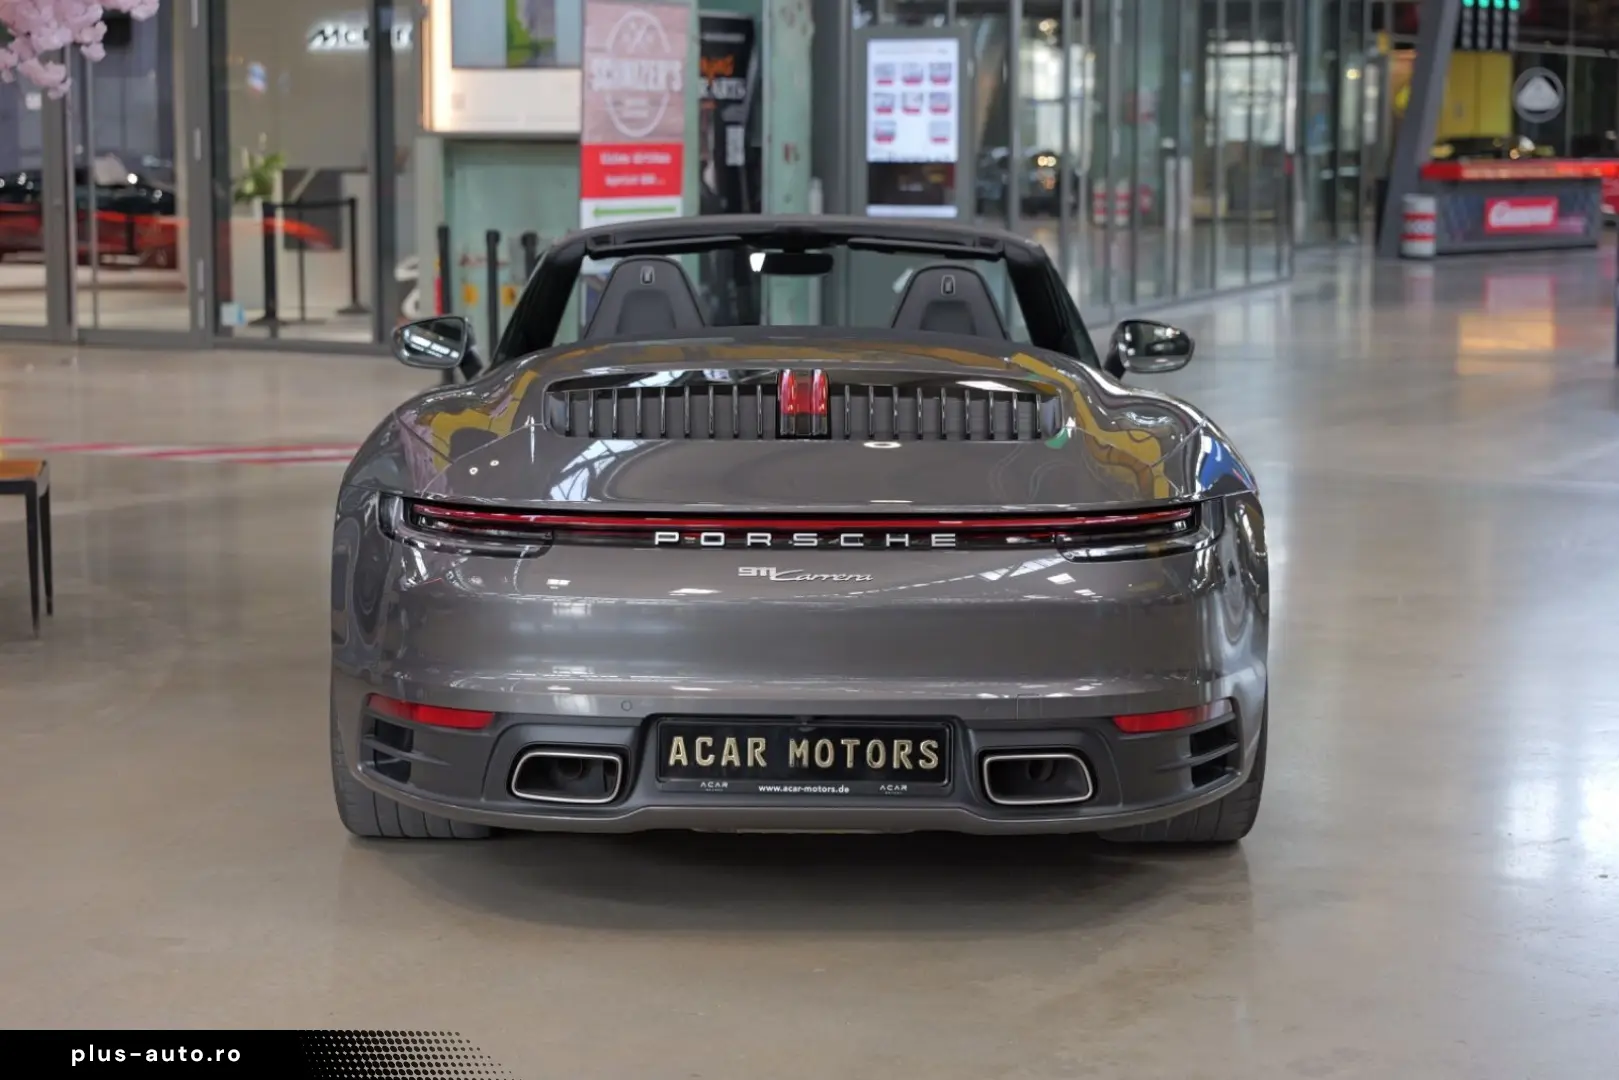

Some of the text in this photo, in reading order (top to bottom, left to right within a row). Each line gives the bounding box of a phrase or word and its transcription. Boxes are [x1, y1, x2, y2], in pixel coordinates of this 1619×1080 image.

[654, 531, 957, 547] PORSCHE
[738, 566, 873, 582] 911 Carrera
[668, 736, 939, 770] ACAR MOTORS
[700, 781, 729, 789] ACAR
[758, 784, 850, 794] www.acar-motors.de
[879, 784, 908, 792] ACAR
